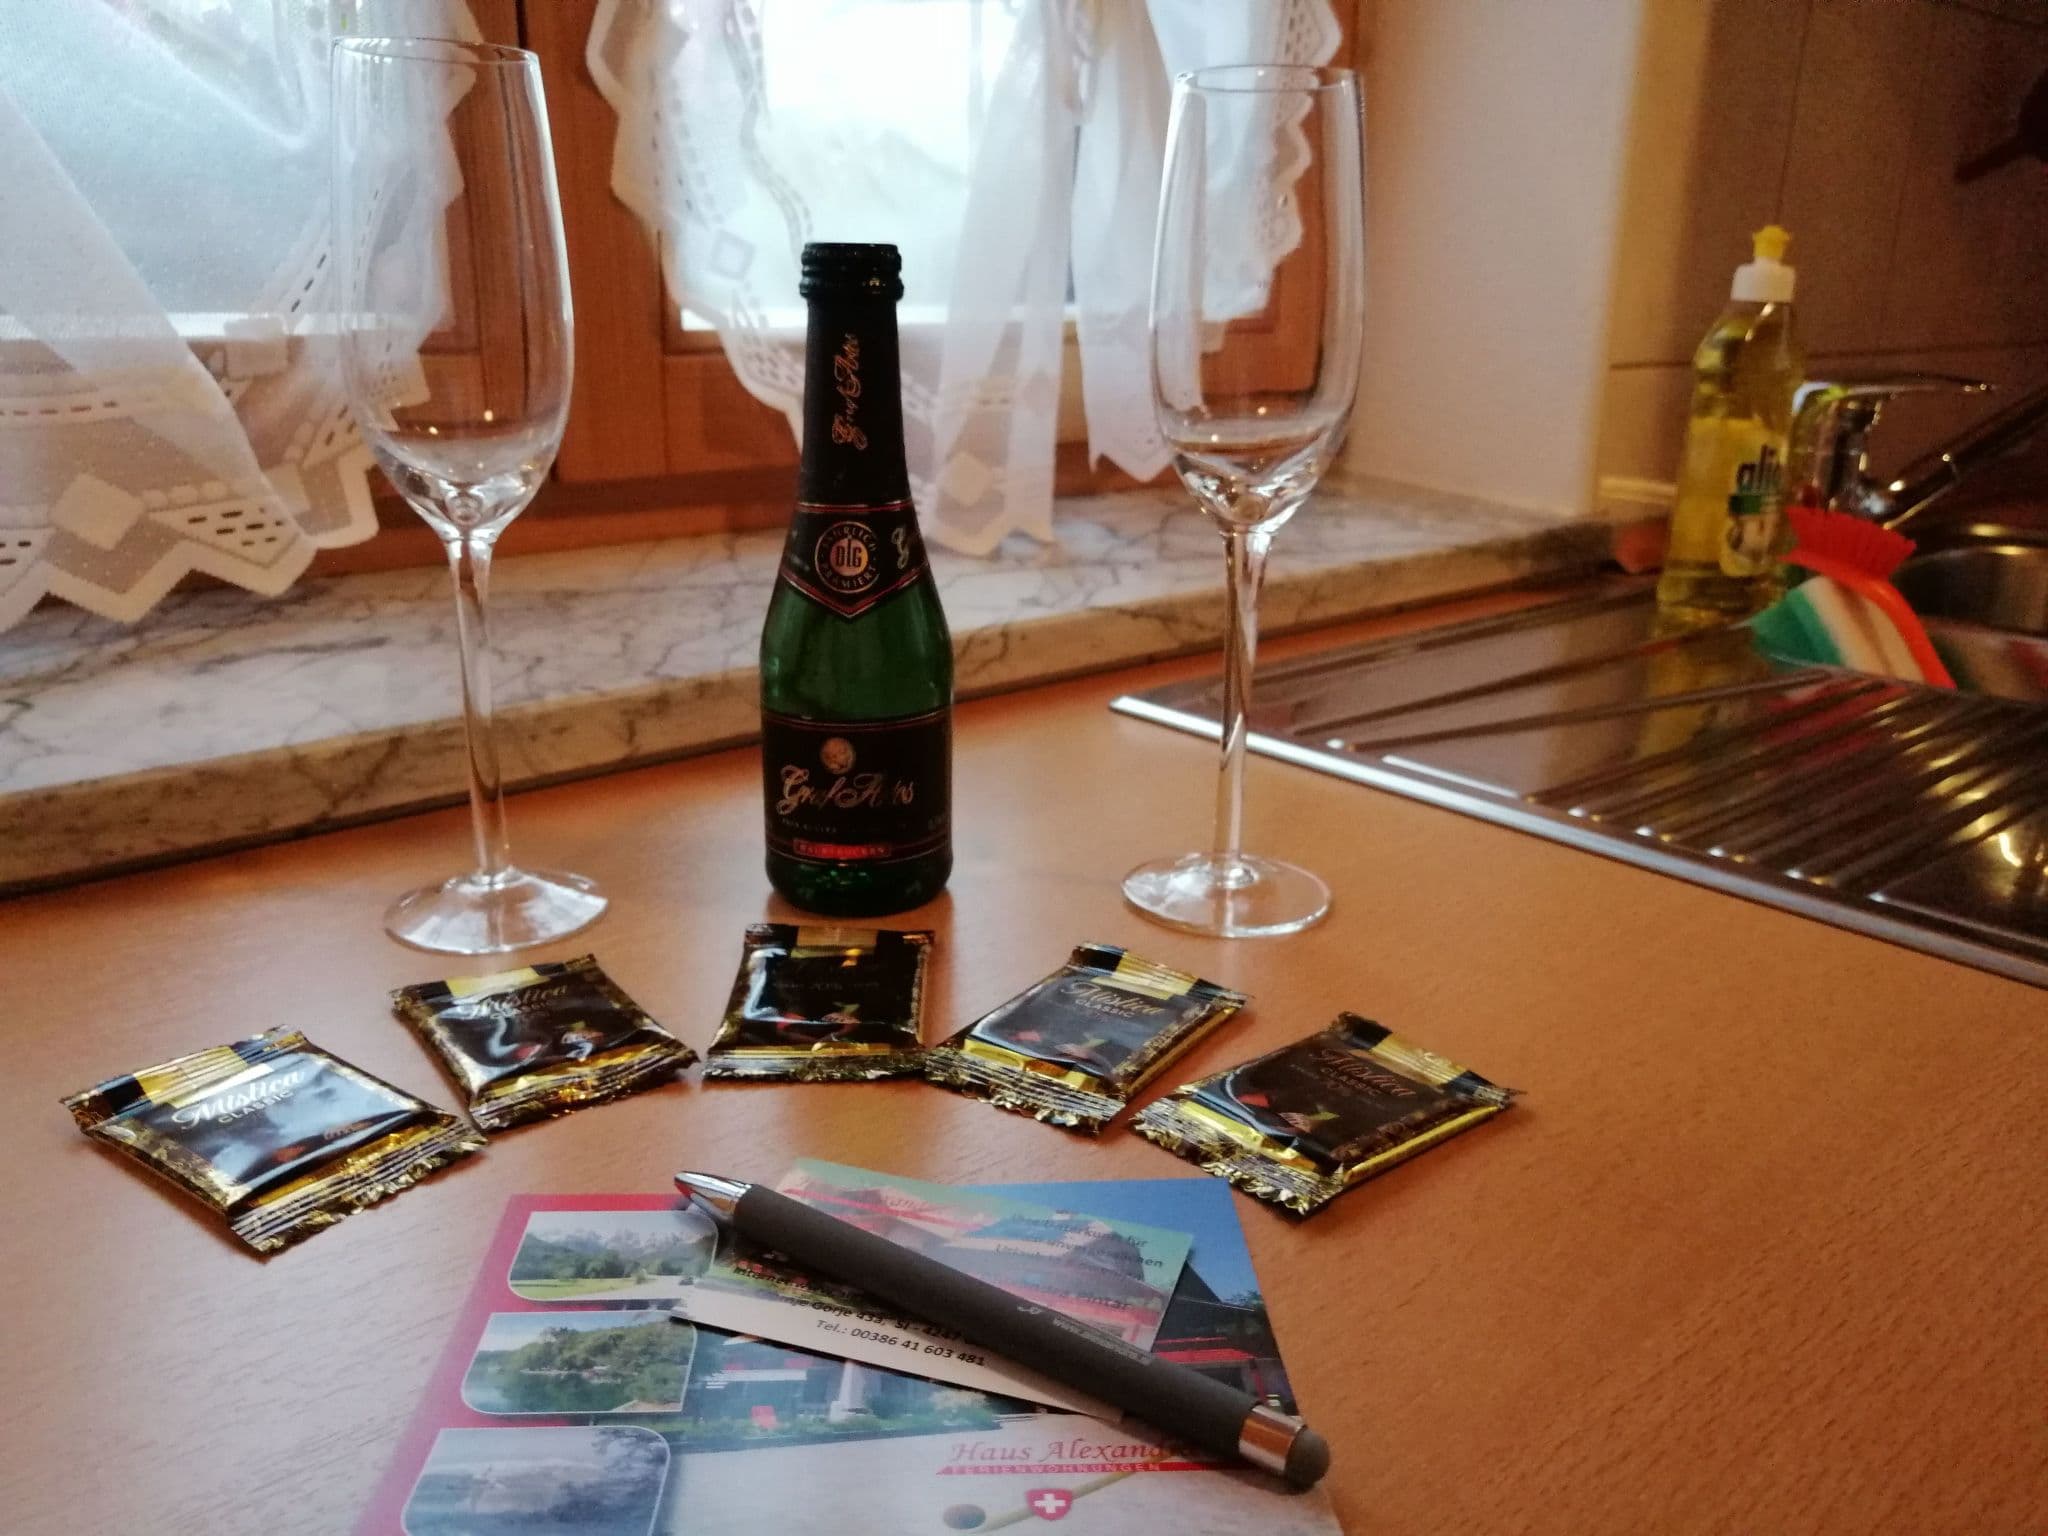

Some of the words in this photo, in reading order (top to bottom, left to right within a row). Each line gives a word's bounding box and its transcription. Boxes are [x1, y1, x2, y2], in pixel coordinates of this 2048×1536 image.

[835, 540, 862, 567] DLG
[217, 1088, 294, 1124] CLASSIC
[850, 1327, 898, 1346] 00386
[900, 1338, 919, 1351] 41
[923, 1344, 952, 1358] 603
[957, 1351, 986, 1367] 481
[952, 1440, 1032, 1463] Haus
[1039, 1437, 1180, 1462] Alexand
[950, 1462, 1161, 1475] FERIENWOHNUNGEN
